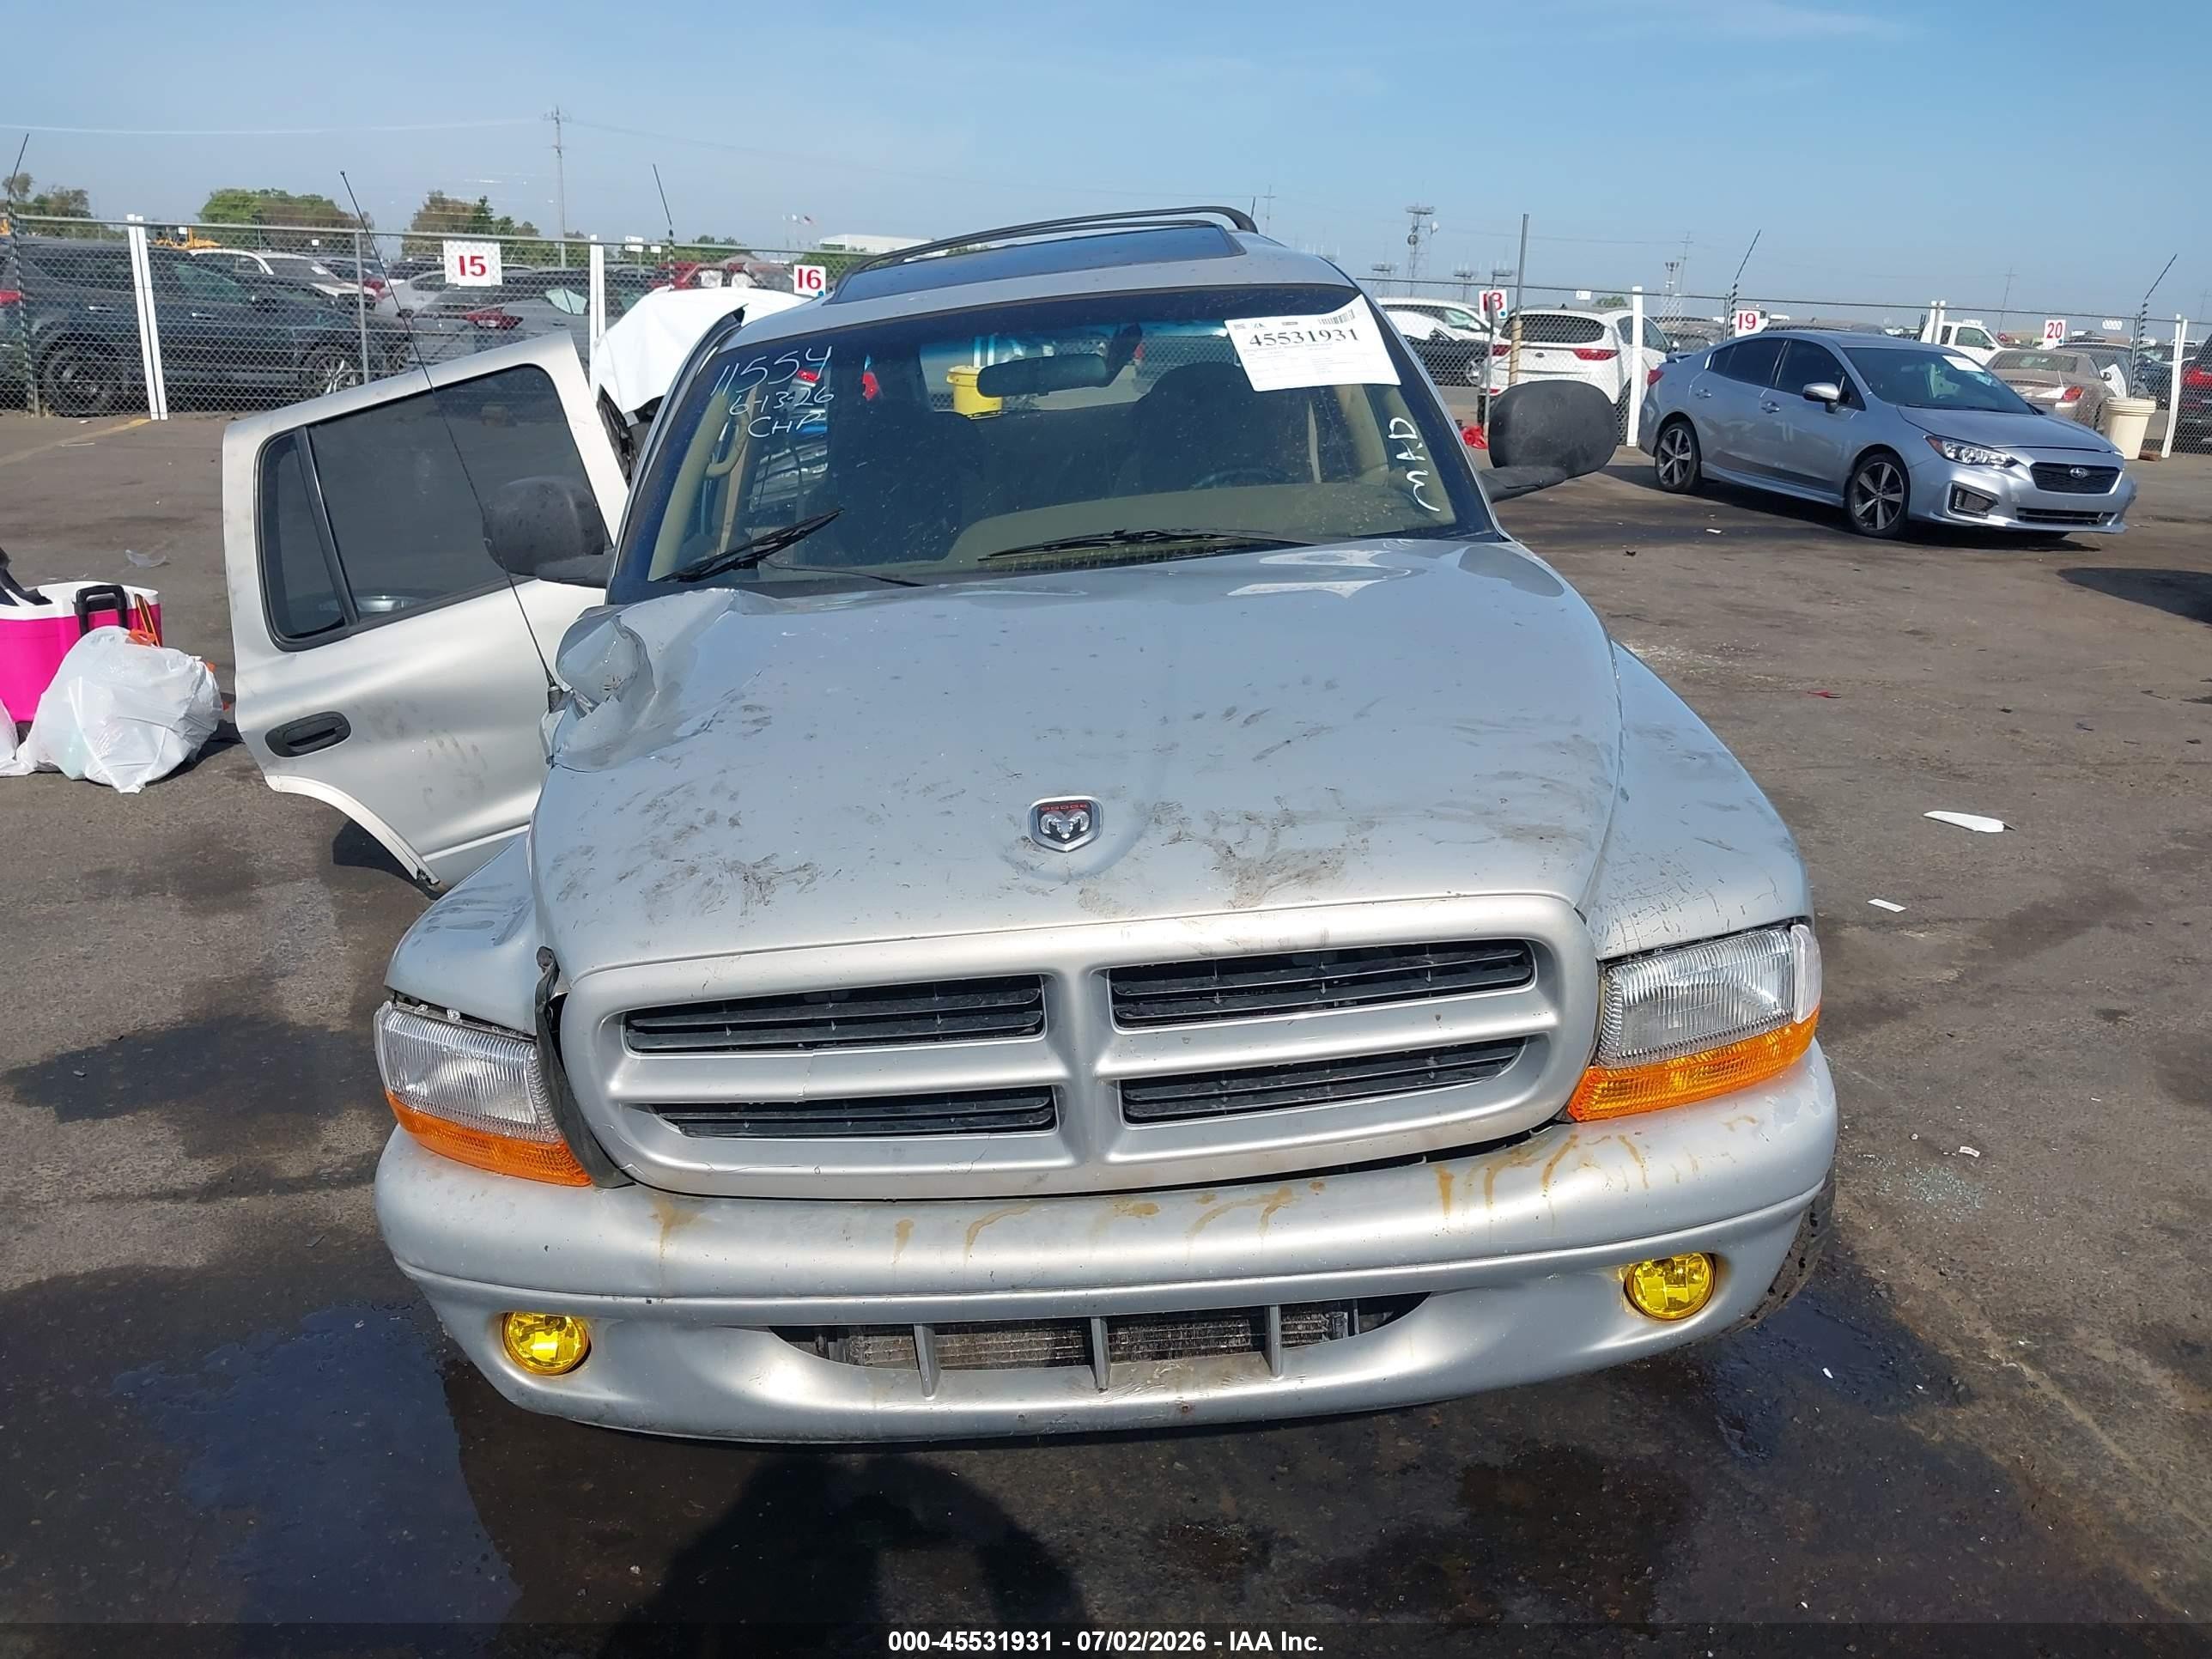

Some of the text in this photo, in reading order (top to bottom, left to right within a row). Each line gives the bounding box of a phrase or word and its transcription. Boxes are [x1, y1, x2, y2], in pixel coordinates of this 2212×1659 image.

[459, 255, 487, 276] 15
[798, 268, 822, 289] 16
[1738, 313, 1757, 331] 19
[2046, 322, 2063, 339] 20
[1249, 328, 1359, 347] 45531931
[709, 345, 833, 397] 11554
[729, 386, 835, 416] 6-13-26
[747, 411, 826, 438] CHP
